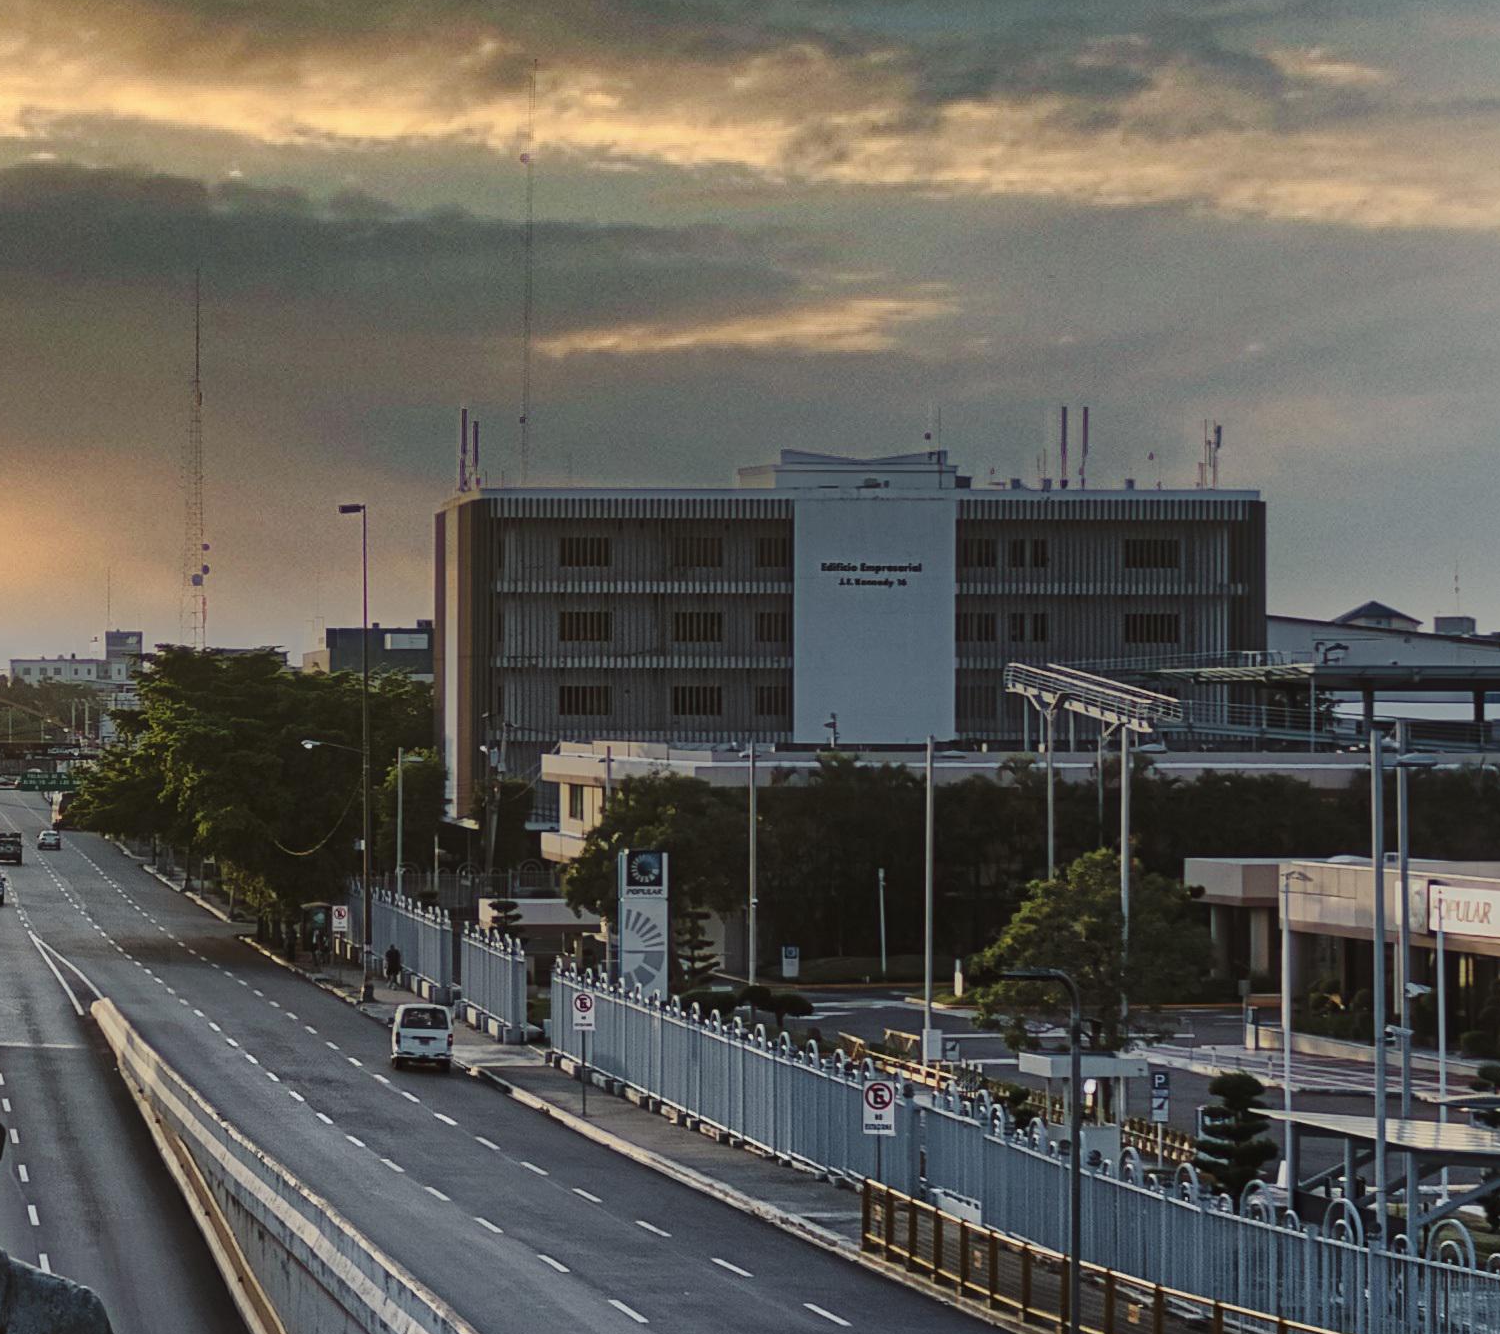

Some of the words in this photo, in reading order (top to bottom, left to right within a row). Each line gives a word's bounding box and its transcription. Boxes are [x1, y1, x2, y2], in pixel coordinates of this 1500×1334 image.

[821, 562, 858, 572] Edificio
[860, 562, 922, 574] Empresarial
[626, 888, 663, 896] POPULAR
[1155, 1074, 1166, 1087] P
